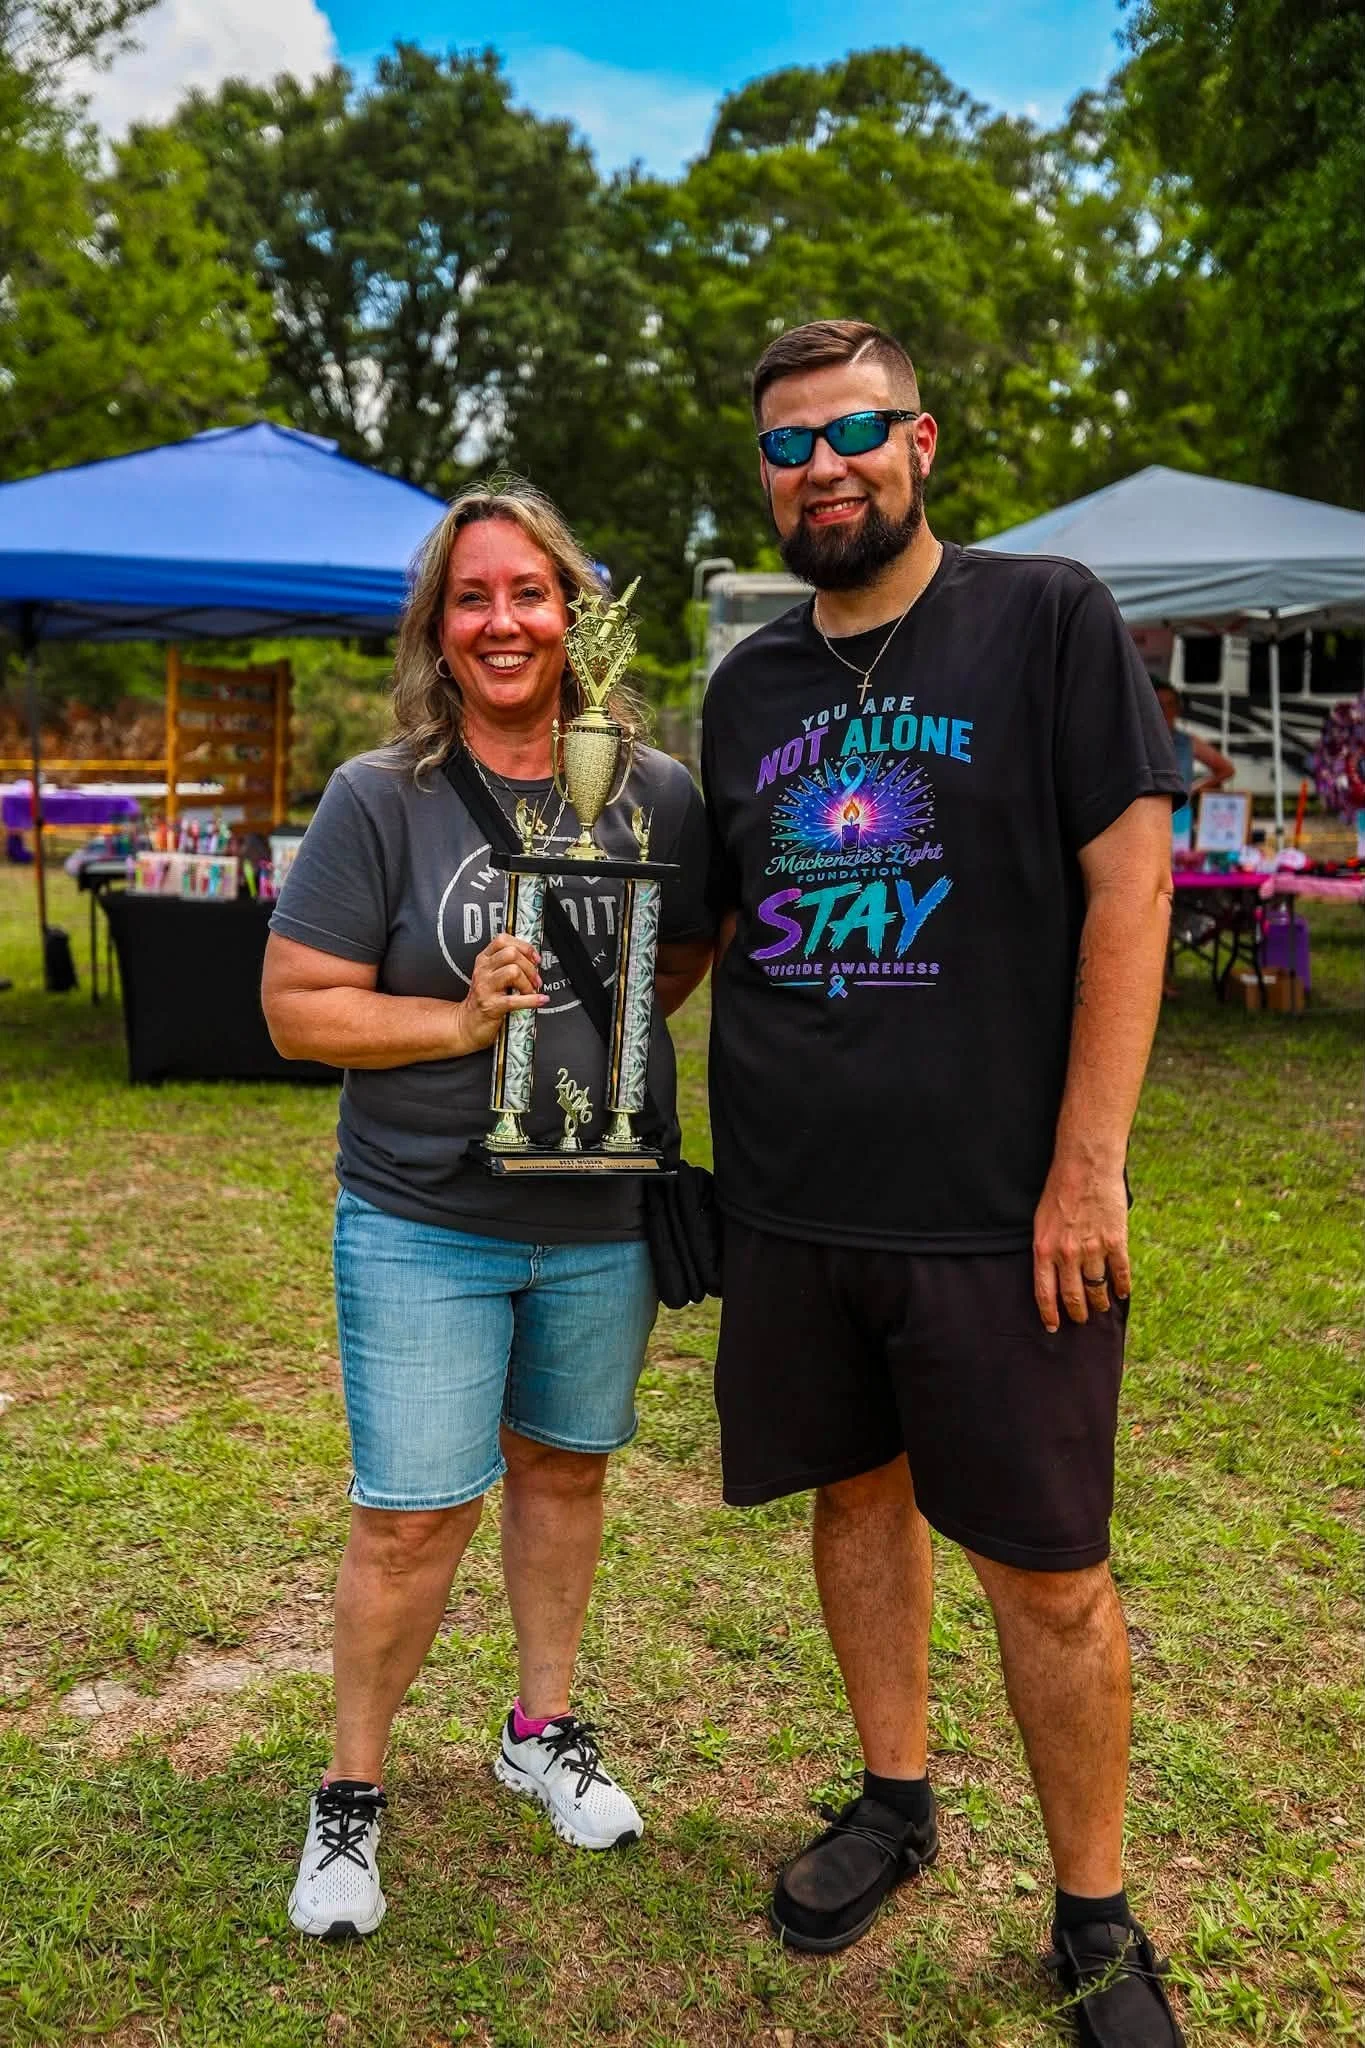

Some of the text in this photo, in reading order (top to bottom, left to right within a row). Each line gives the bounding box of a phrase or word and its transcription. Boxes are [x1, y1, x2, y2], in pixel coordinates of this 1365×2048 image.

[801, 695, 915, 732] YOU ARE
[754, 713, 974, 794] NOT ALONE
[764, 840, 944, 876] Mackenzie's Light
[797, 866, 902, 884] FOUNDATION
[463, 895, 617, 945] DEIT
[749, 874, 955, 960] STAY
[829, 961, 940, 976] AWARENESS
